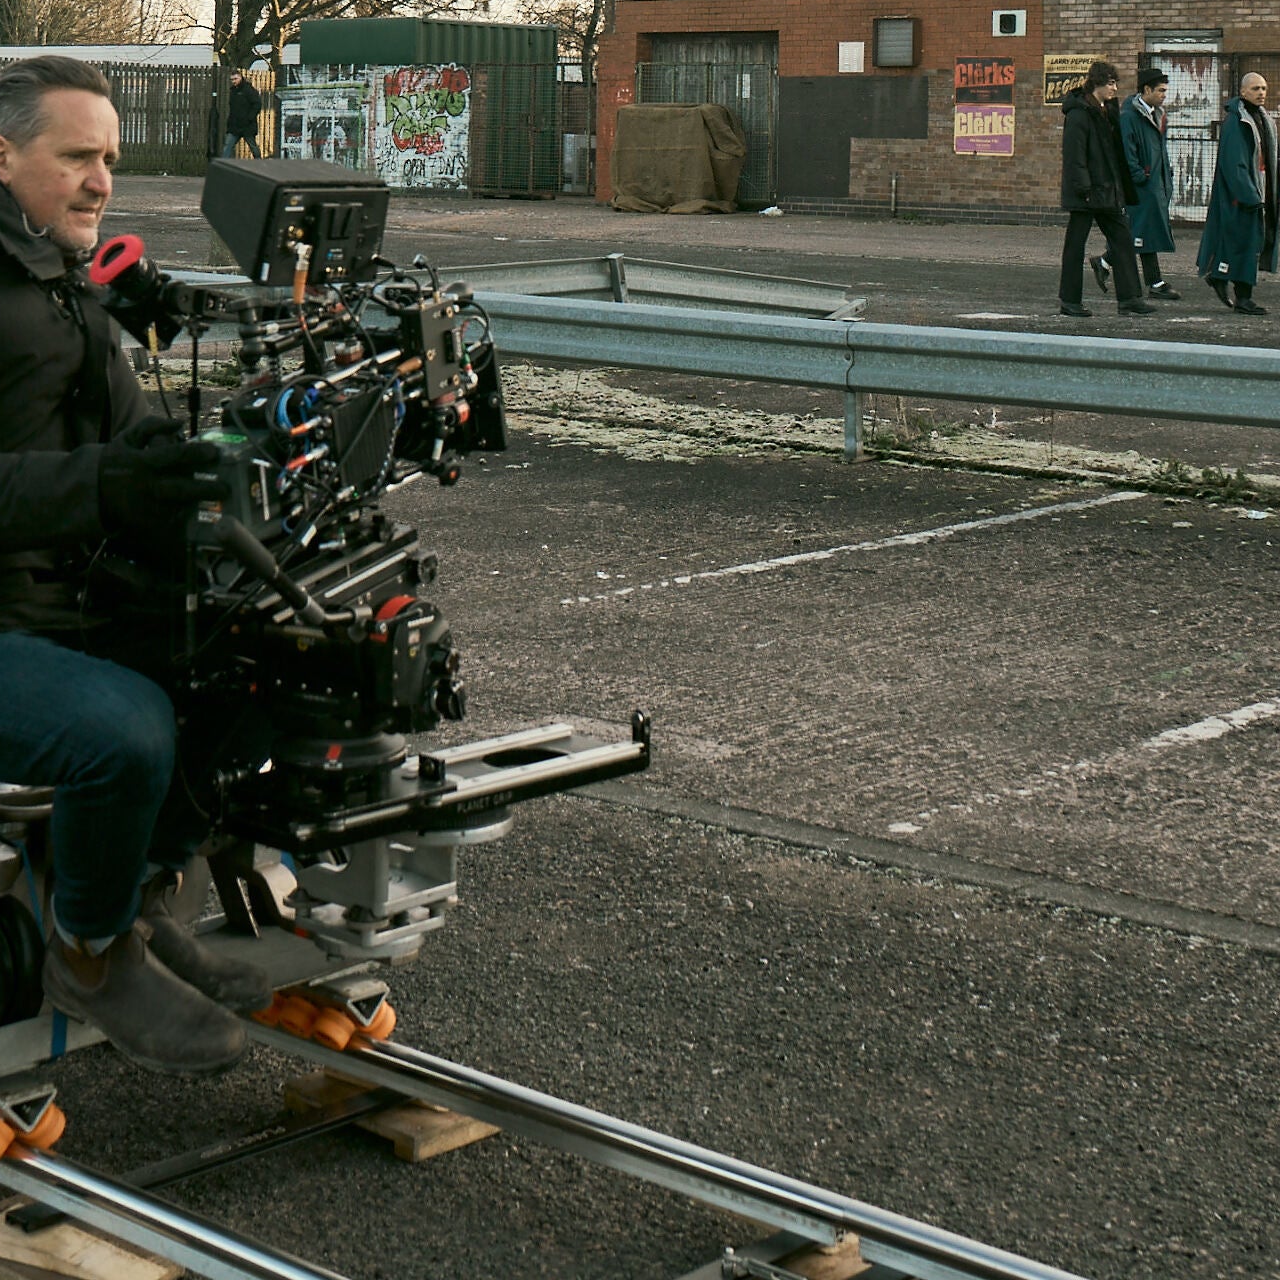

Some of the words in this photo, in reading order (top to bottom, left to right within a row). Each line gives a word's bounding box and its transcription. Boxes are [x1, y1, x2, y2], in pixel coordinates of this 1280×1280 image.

[1050, 57, 1069, 65] LARRY
[1046, 74, 1090, 100] REGGA
[954, 111, 1015, 136] Clërks
